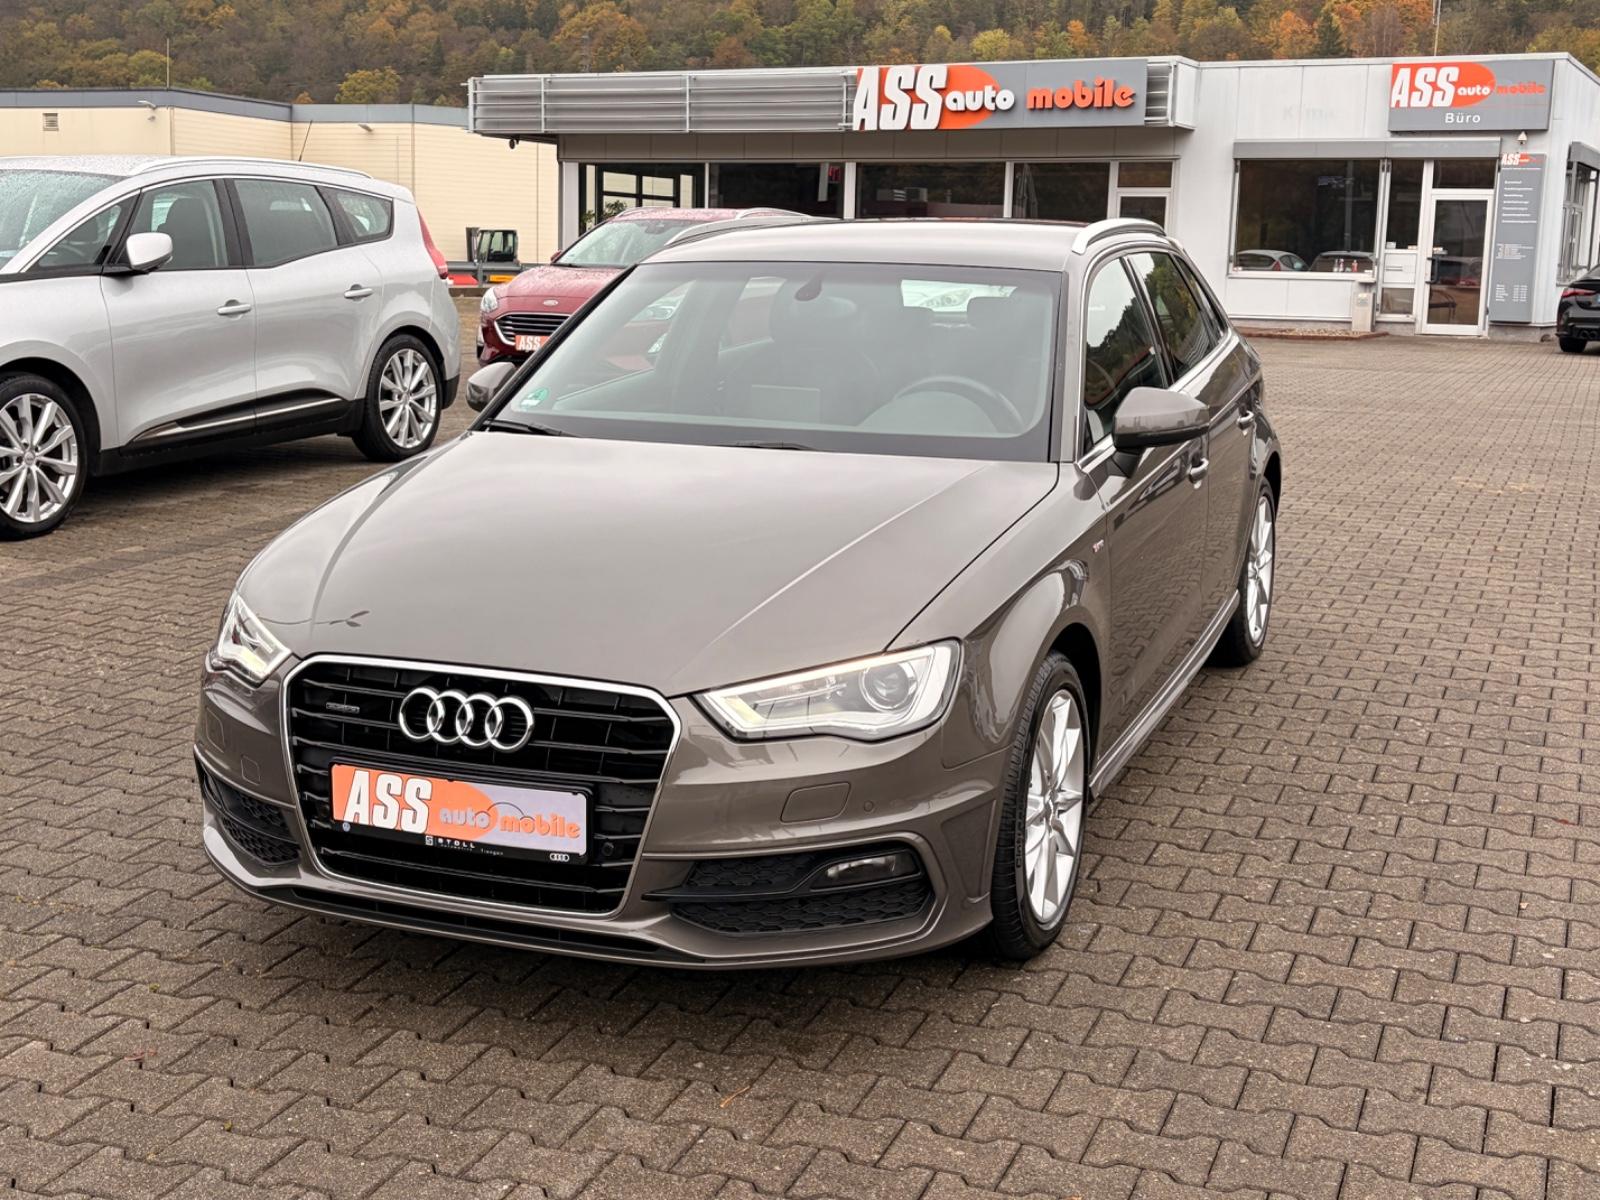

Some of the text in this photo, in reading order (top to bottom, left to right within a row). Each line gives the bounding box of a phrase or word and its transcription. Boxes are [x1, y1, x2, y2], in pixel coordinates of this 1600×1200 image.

[852, 65, 1136, 131] ASS auto mobile
[1390, 66, 1546, 108] ASS auto mobile
[1445, 112, 1481, 124] Büro
[1501, 153, 1520, 165] ASS
[520, 336, 541, 351] ASS
[343, 769, 581, 839] ASS auto mobile
